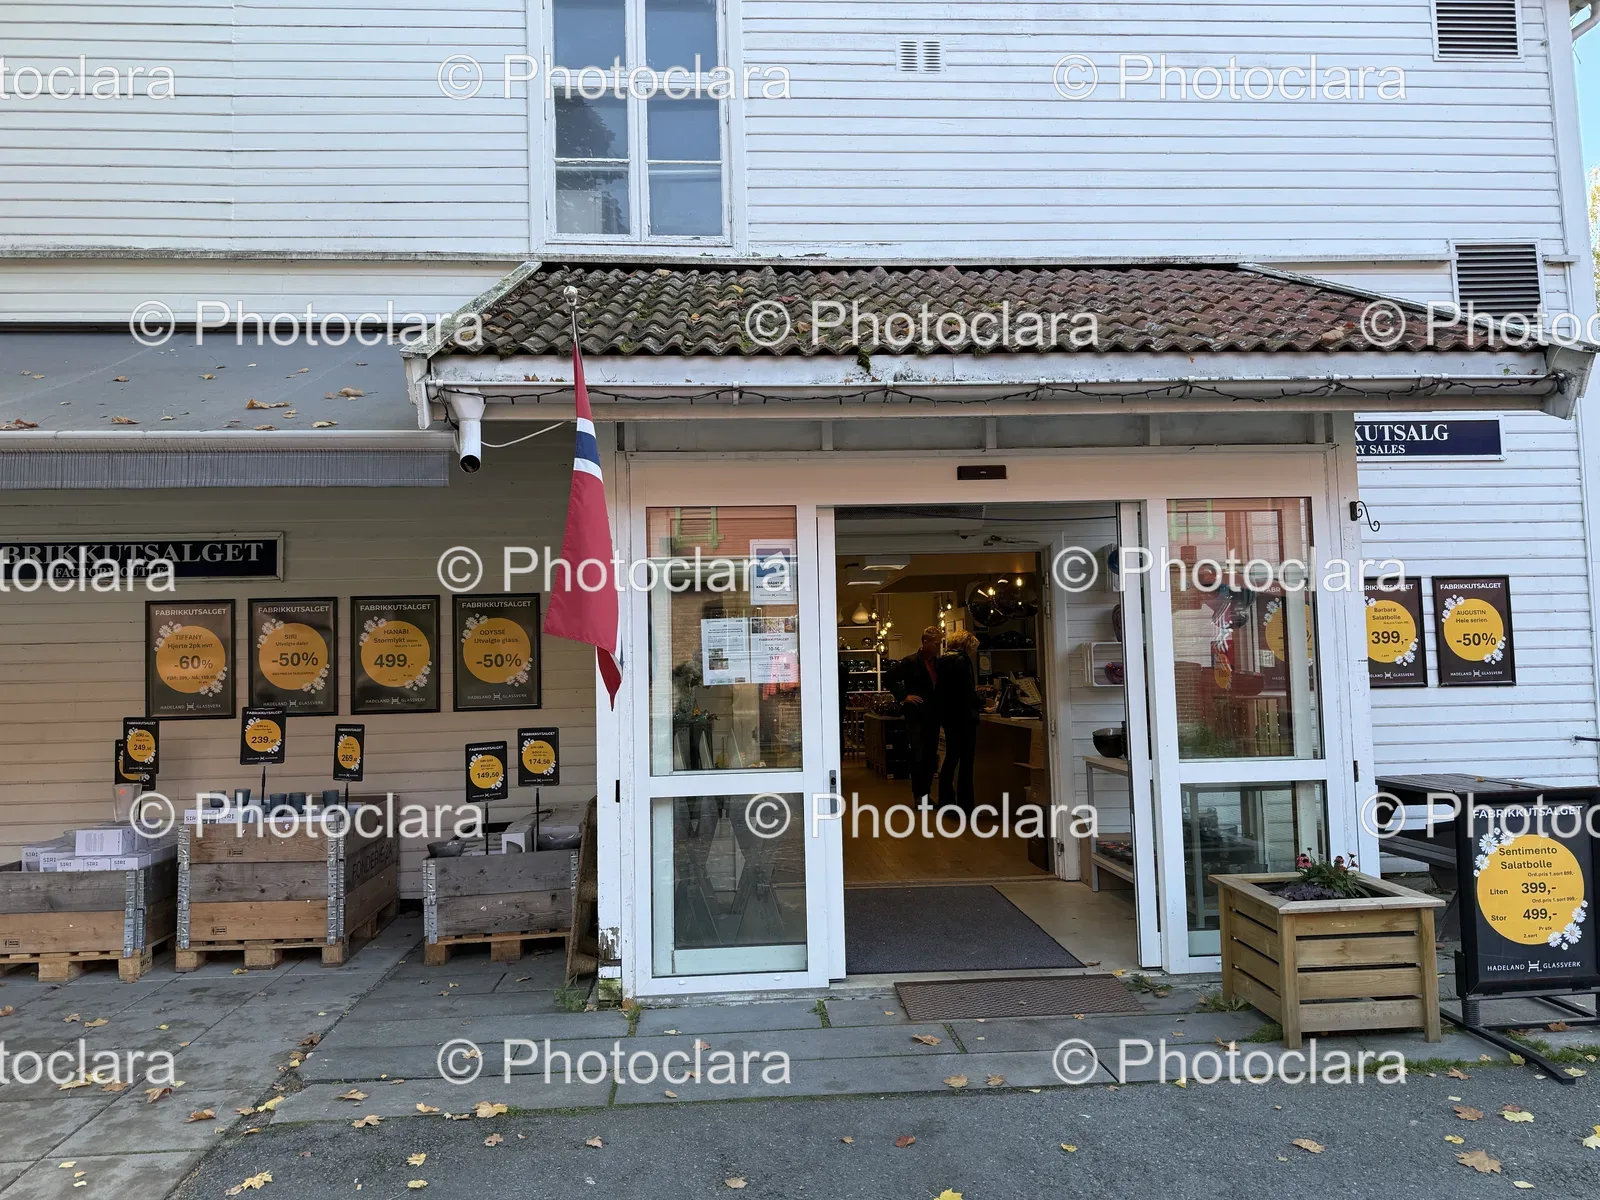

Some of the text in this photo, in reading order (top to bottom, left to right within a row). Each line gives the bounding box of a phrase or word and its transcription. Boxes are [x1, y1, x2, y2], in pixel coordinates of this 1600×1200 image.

[1370, 444, 1405, 454] SALES
[461, 601, 532, 609] FABRIKKUTSALGET
[155, 608, 227, 616] FABRIKKUTSALGET
[1371, 630, 1408, 645] 399,-
[1456, 632, 1496, 646] -50%
[174, 655, 213, 669] -60%
[272, 652, 318, 666] -50%
[374, 653, 414, 669] 499,-
[476, 653, 522, 667] -50%
[1473, 806, 1582, 819] FABRIKKUTSALGET
[1499, 847, 1557, 856] Sentimento
[1501, 860, 1552, 869] Salatbolle
[1521, 882, 1556, 895] 399,-
[1523, 908, 1557, 921] 499,-
[1543, 961, 1581, 969] GLASSVERK
